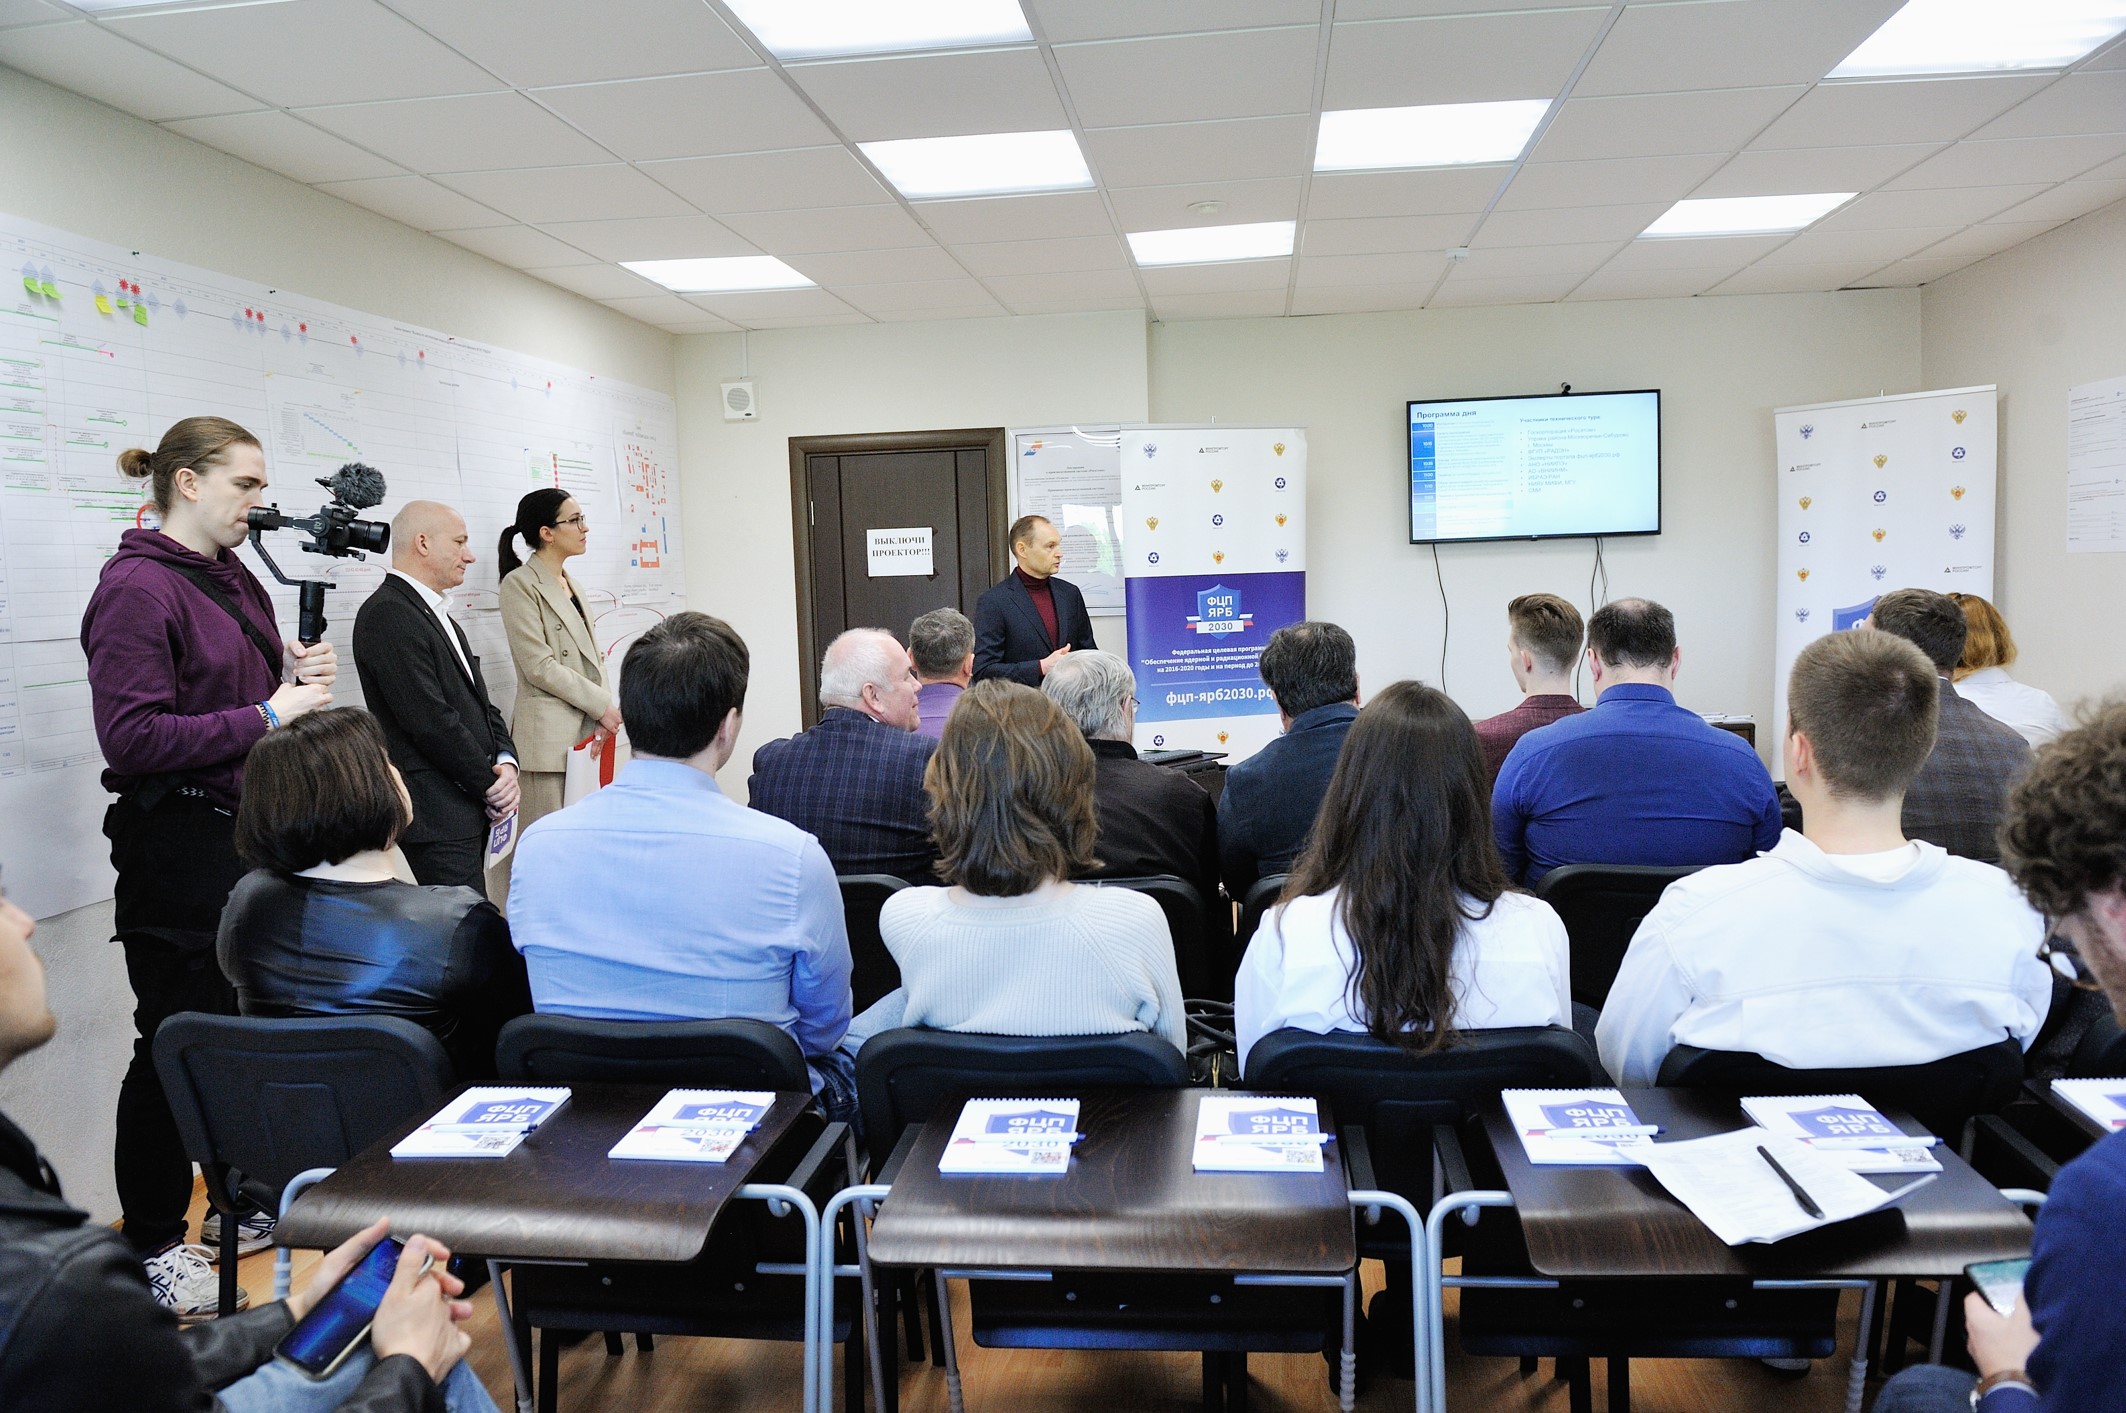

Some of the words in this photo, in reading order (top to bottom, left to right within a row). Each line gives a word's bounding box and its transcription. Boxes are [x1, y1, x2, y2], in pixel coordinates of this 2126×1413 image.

[874, 537, 925, 545] ВЫКЛЮЧИ
[872, 548, 930, 557] ПРОЕКТОР!!!
[1207, 596, 1233, 607] ФЦП
[1208, 607, 1233, 618] ЯРБ
[1208, 622, 1233, 631] 2030
[1184, 656, 1210, 664] ядерной
[1216, 652, 1258, 662] радиационной
[487, 1104, 542, 1114] ФЦП
[698, 1108, 754, 1118] ФЦП
[1565, 1108, 1626, 1119] ФЦП
[474, 1114, 531, 1122] ЯРБ
[1008, 1117, 1066, 1128] ФЦП
[1250, 1115, 1308, 1126] ФЦП
[1572, 1118, 1632, 1128] ЯРБ
[1816, 1114, 1880, 1125] ФЦП
[681, 1128, 735, 1136] 2030
[1252, 1124, 1308, 1134] ЯРБ
[1828, 1124, 1891, 1135] ЯРБ
